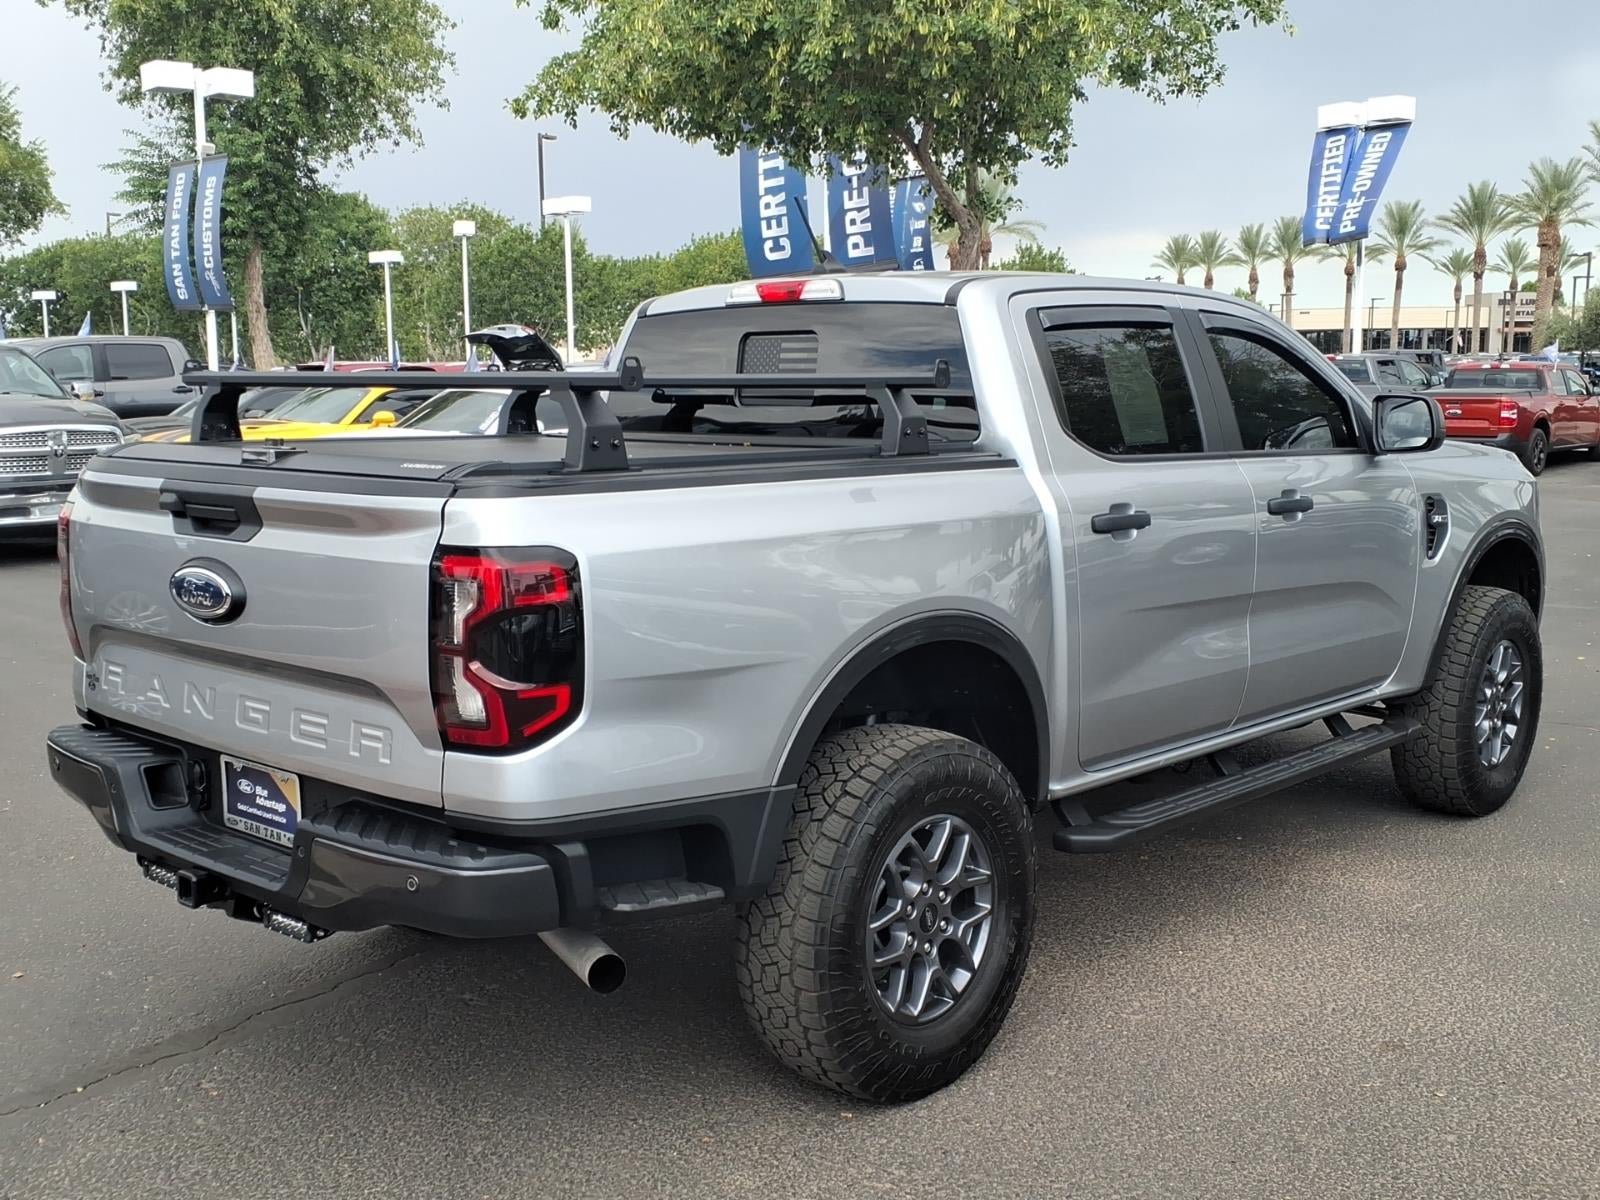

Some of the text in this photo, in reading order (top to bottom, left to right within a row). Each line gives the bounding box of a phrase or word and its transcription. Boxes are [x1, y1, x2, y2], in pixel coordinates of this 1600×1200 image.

[203, 175, 217, 269] CUSTOMS
[841, 149, 875, 259] PRE-O
[1315, 134, 1347, 230] CERTIFIED
[1340, 131, 1393, 234] PRE-OWNED
[171, 172, 189, 301] SAN TAN FORD
[101, 659, 393, 765] RANGER
[244, 821, 260, 835] SAN
[263, 826, 282, 841] TAN
